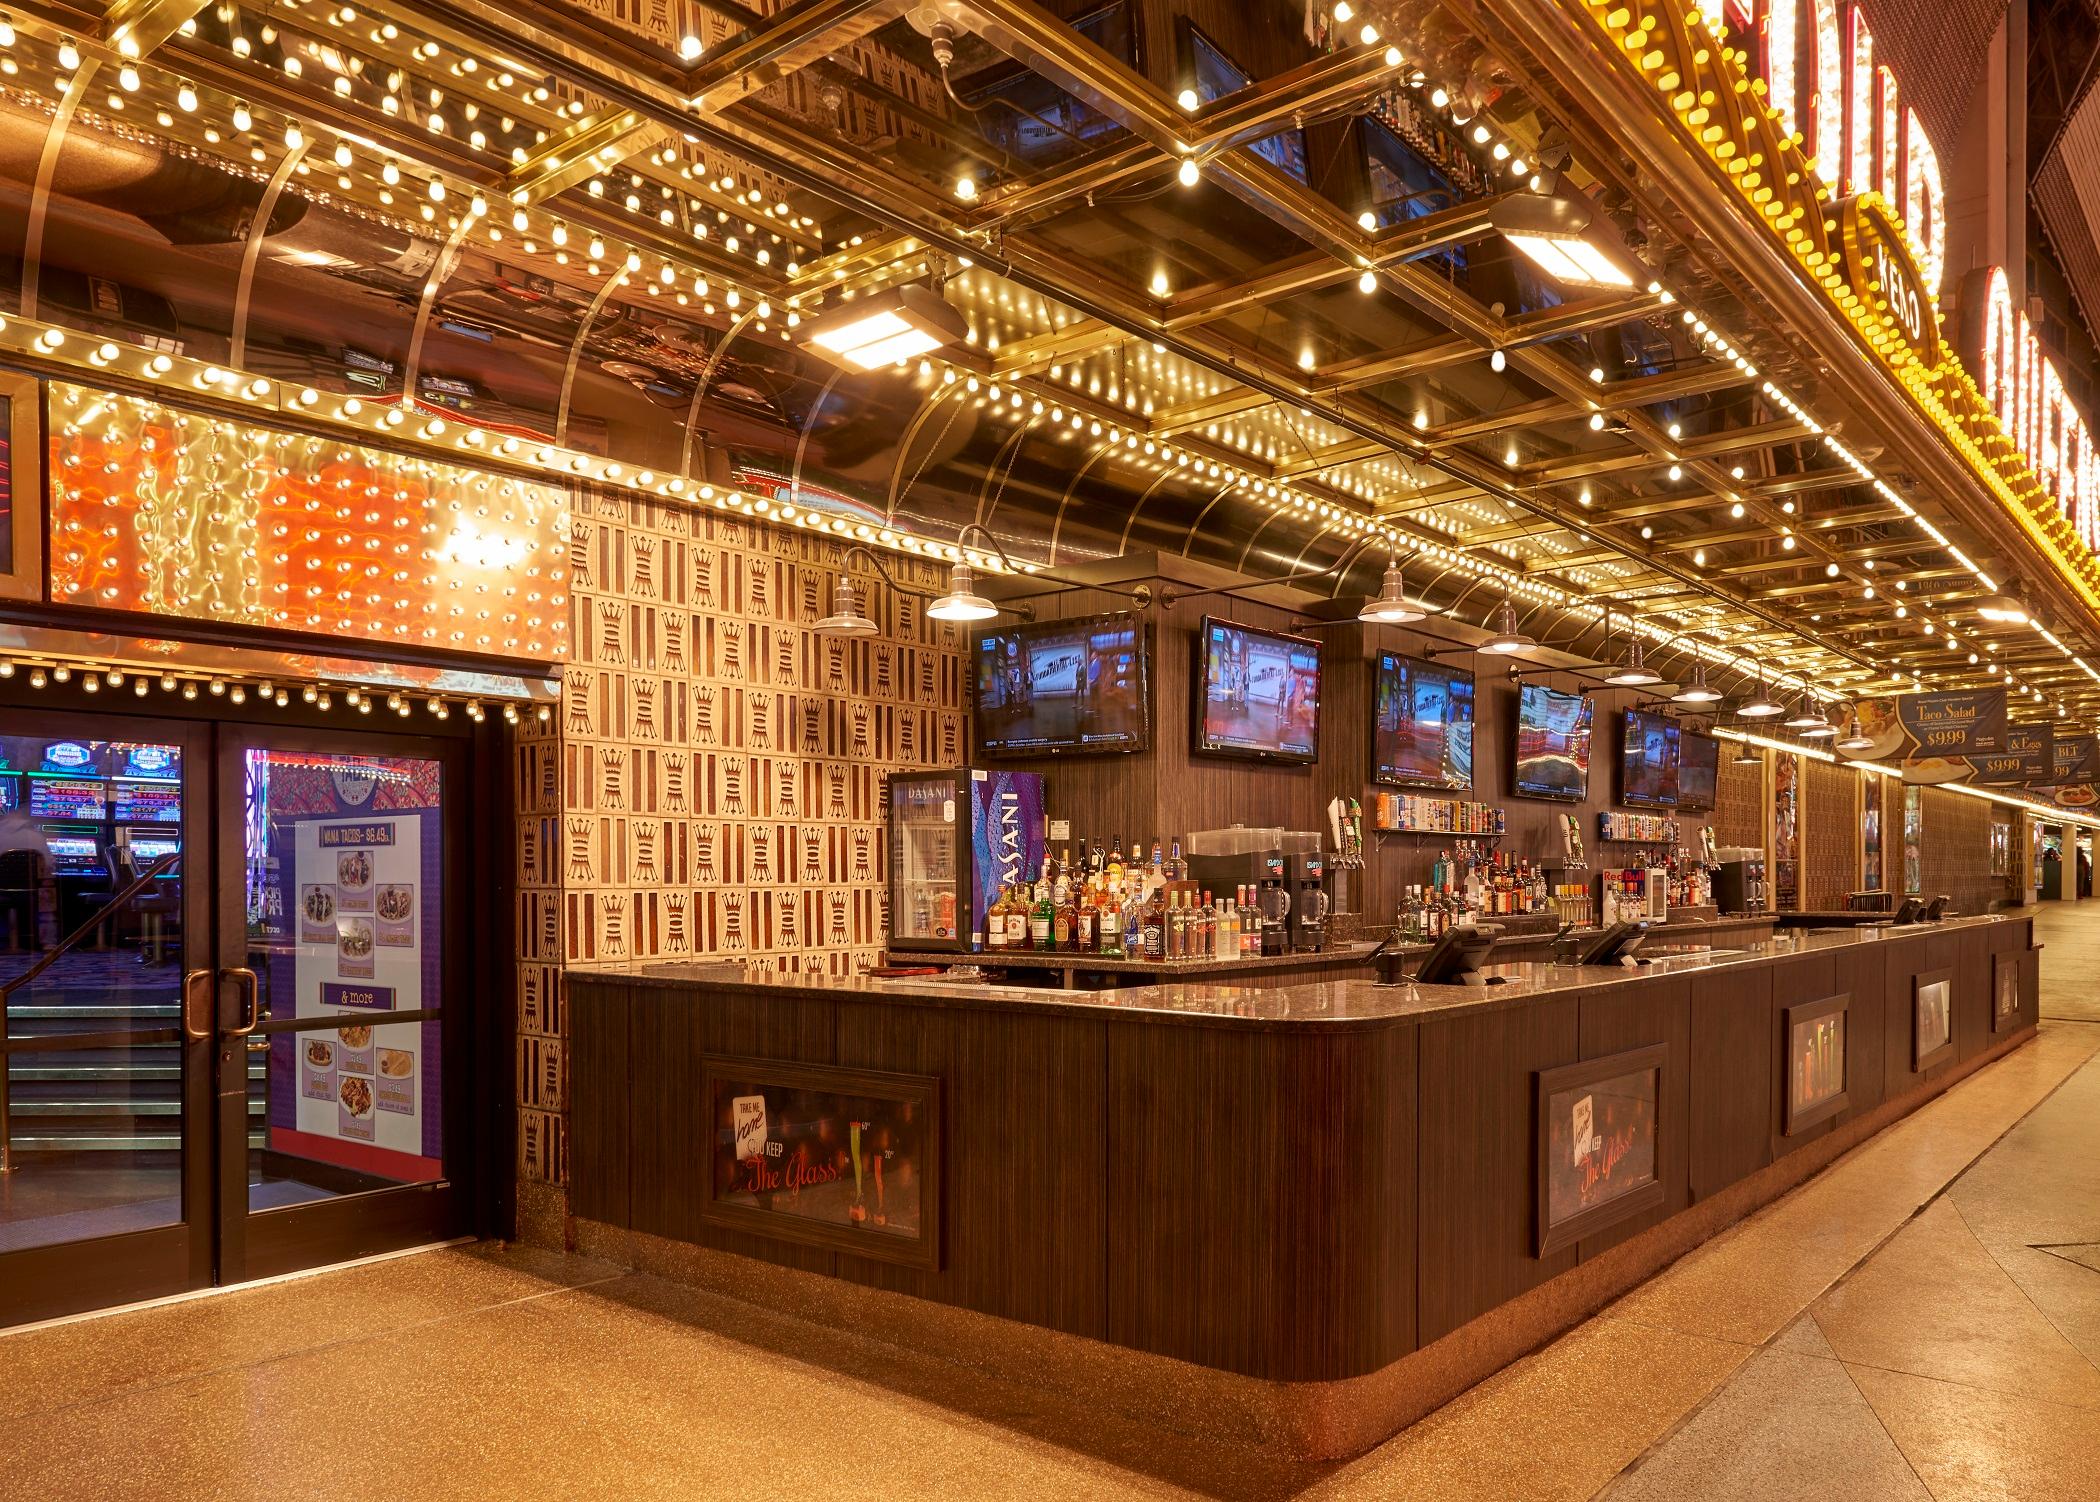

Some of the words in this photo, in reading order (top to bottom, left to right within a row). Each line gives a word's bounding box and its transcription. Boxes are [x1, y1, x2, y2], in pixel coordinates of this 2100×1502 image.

[1877, 243, 1921, 340] KENO
[1915, 703, 1942, 721] Taco
[1943, 703, 1976, 719] Salad
[1926, 729, 1966, 747] $9.99
[2011, 739, 2020, 750] &
[2021, 736, 2042, 750] Eggs
[2058, 745, 2079, 758] BLT
[1986, 758, 2020, 773] $9.99
[908, 787, 946, 799] DASANI
[998, 793, 1022, 885] ASANI
[1604, 871, 1624, 881] Red
[1625, 871, 1644, 881] Bull
[341, 990, 348, 1004] &
[349, 991, 374, 1004] more
[739, 1103, 752, 1114] TAKE
[752, 1102, 760, 1113] ME
[736, 1111, 764, 1143] home
[766, 1140, 783, 1158] KEEP
[745, 1154, 781, 1193] The
